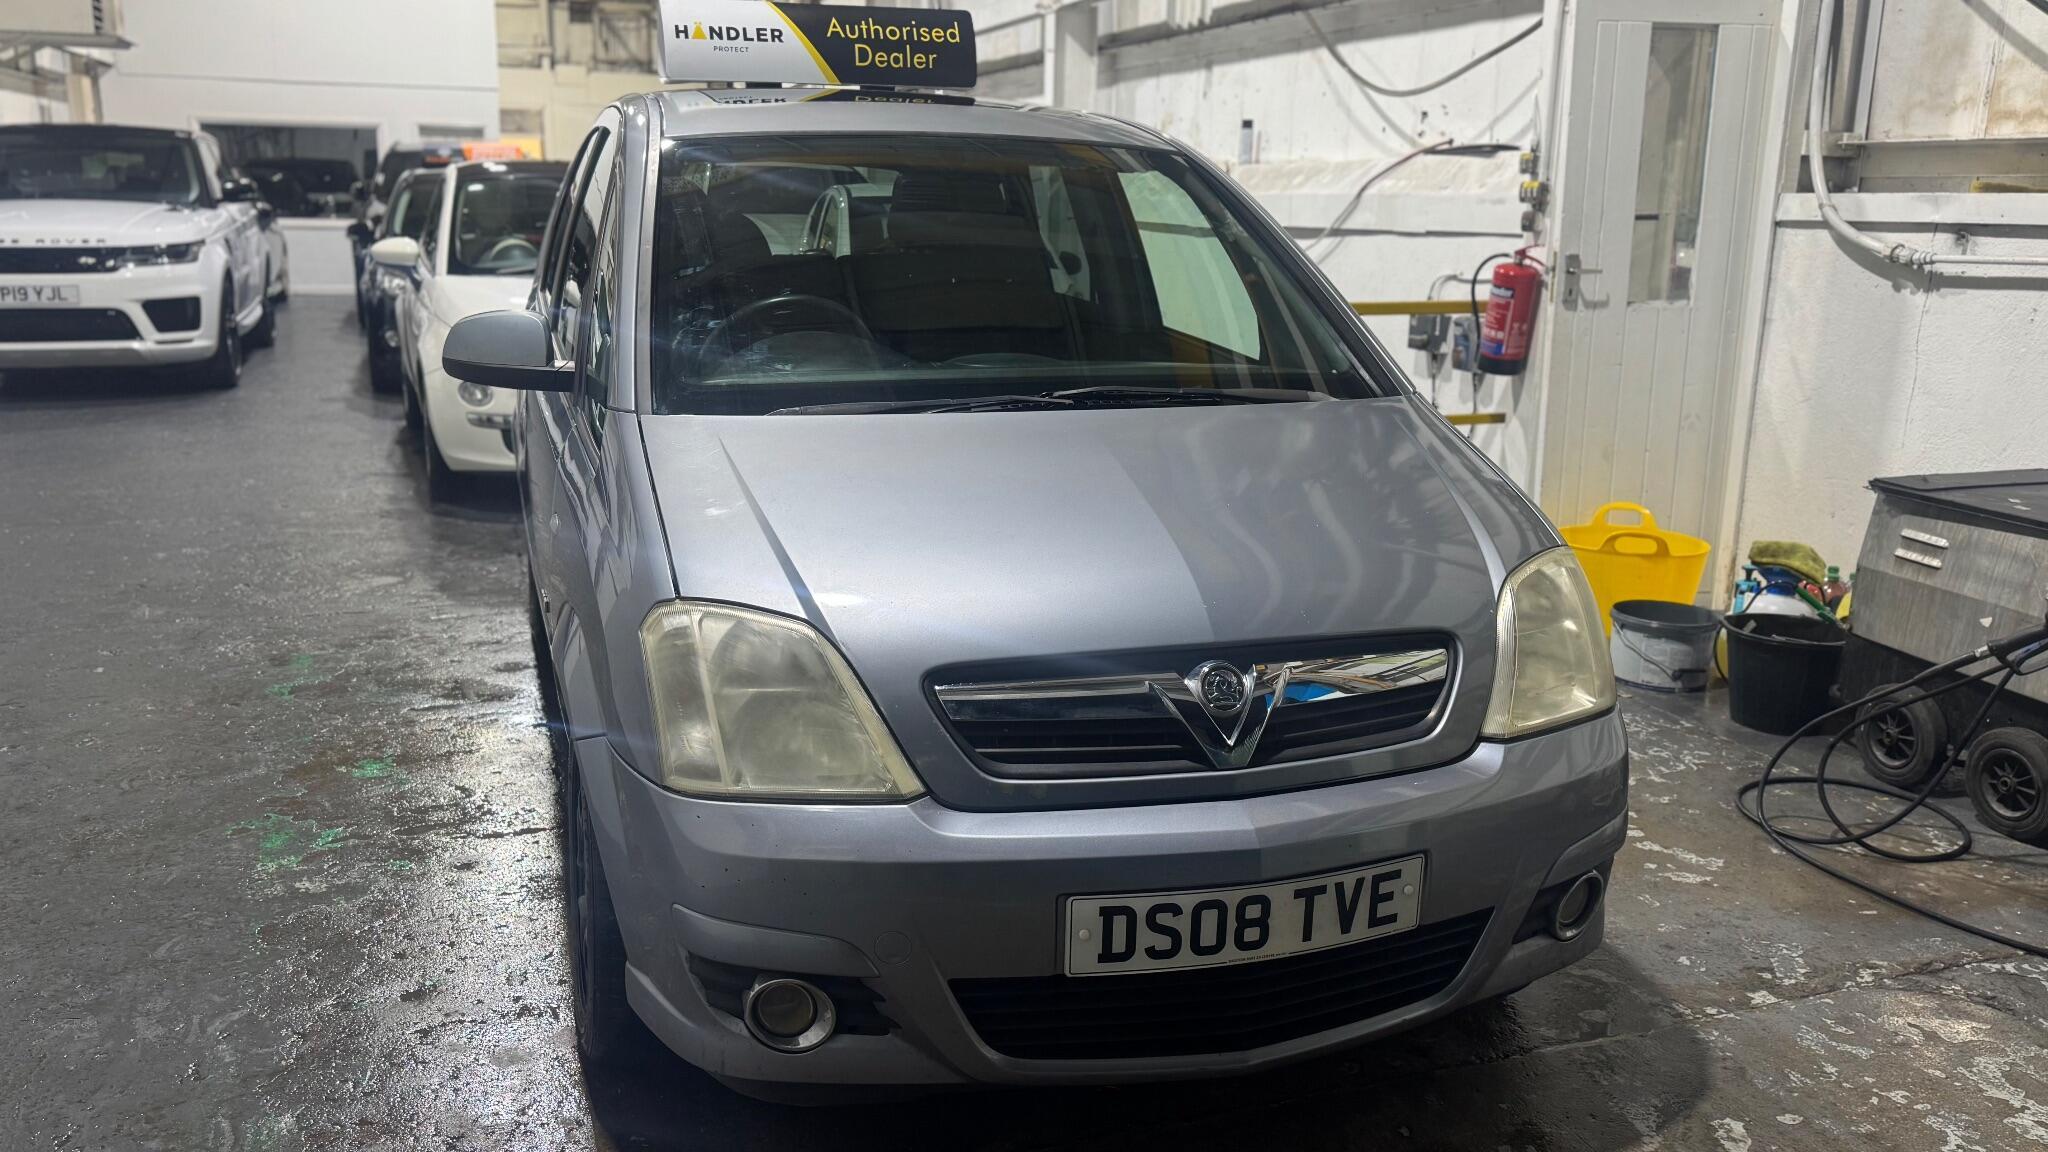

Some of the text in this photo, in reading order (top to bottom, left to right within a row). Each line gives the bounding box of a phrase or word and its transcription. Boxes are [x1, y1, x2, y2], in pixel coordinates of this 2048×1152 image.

[826, 17, 960, 43] Authorised
[713, 45, 749, 53] PROTECT
[855, 44, 938, 69] Dealer
[33, 286, 68, 301] YJL
[1098, 869, 1402, 963] DS08 TVE
